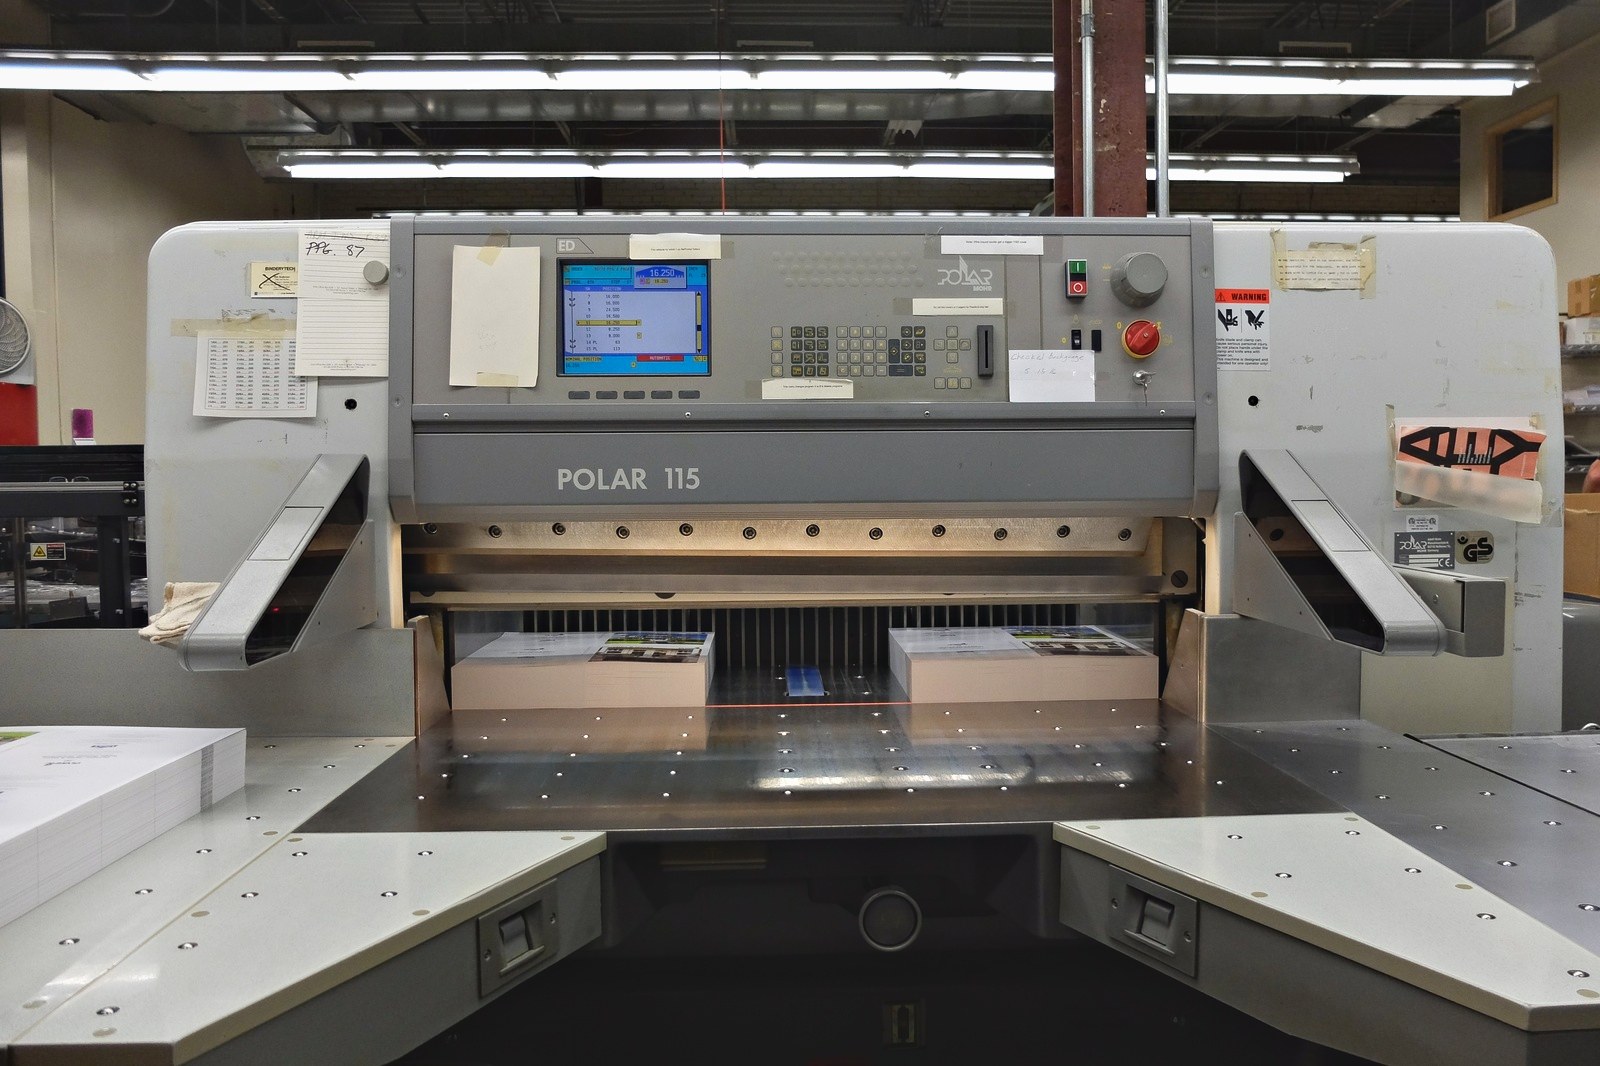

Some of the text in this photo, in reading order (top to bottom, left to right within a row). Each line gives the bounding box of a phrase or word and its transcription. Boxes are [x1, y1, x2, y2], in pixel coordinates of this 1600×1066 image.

[346, 244, 365, 258] 87
[558, 240, 576, 252] ED
[650, 269, 675, 277] 16.250
[937, 255, 993, 286] POLAR
[558, 467, 700, 490] POLAR 115
[1400, 535, 1428, 550] POLAR
[1463, 537, 1493, 562] GS
[1438, 558, 1451, 567] CE
